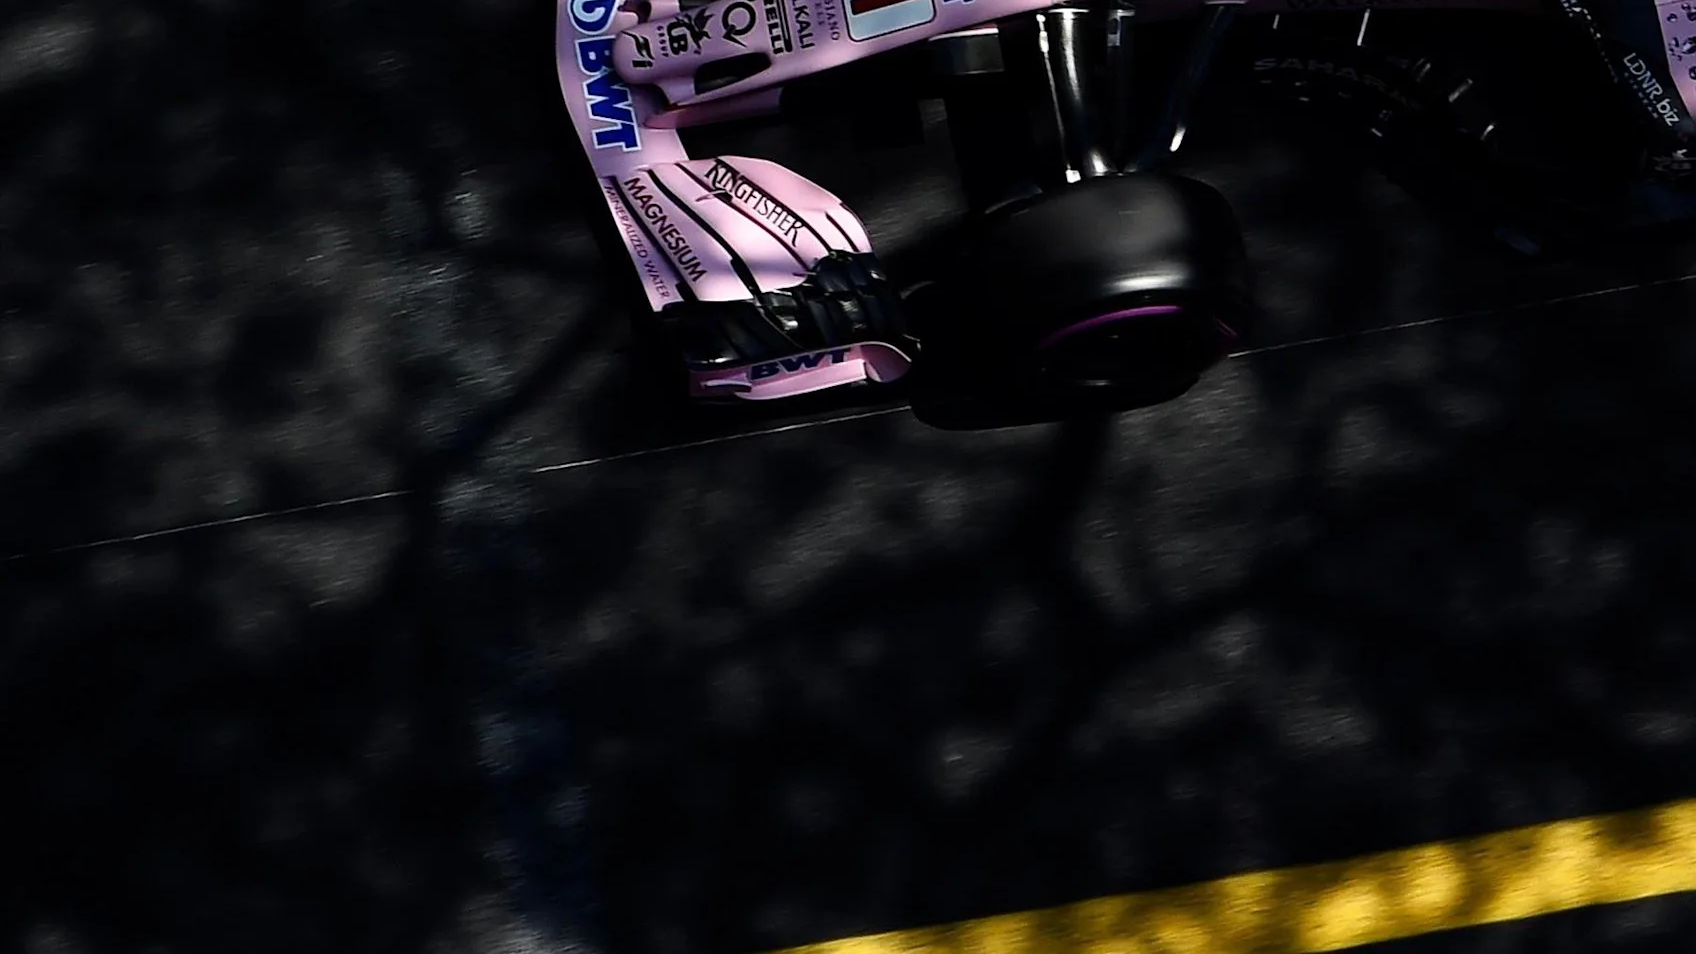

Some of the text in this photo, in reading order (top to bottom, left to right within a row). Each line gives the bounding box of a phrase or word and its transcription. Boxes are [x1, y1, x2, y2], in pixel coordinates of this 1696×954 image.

[575, 38, 642, 153] BWT
[1622, 52, 1680, 127] LDNR.biz
[604, 185, 672, 301] MINERALIZED WATER
[623, 176, 708, 283] MAGNESIUM
[704, 160, 807, 248] KINGFISHER
[749, 347, 852, 381] BWT
